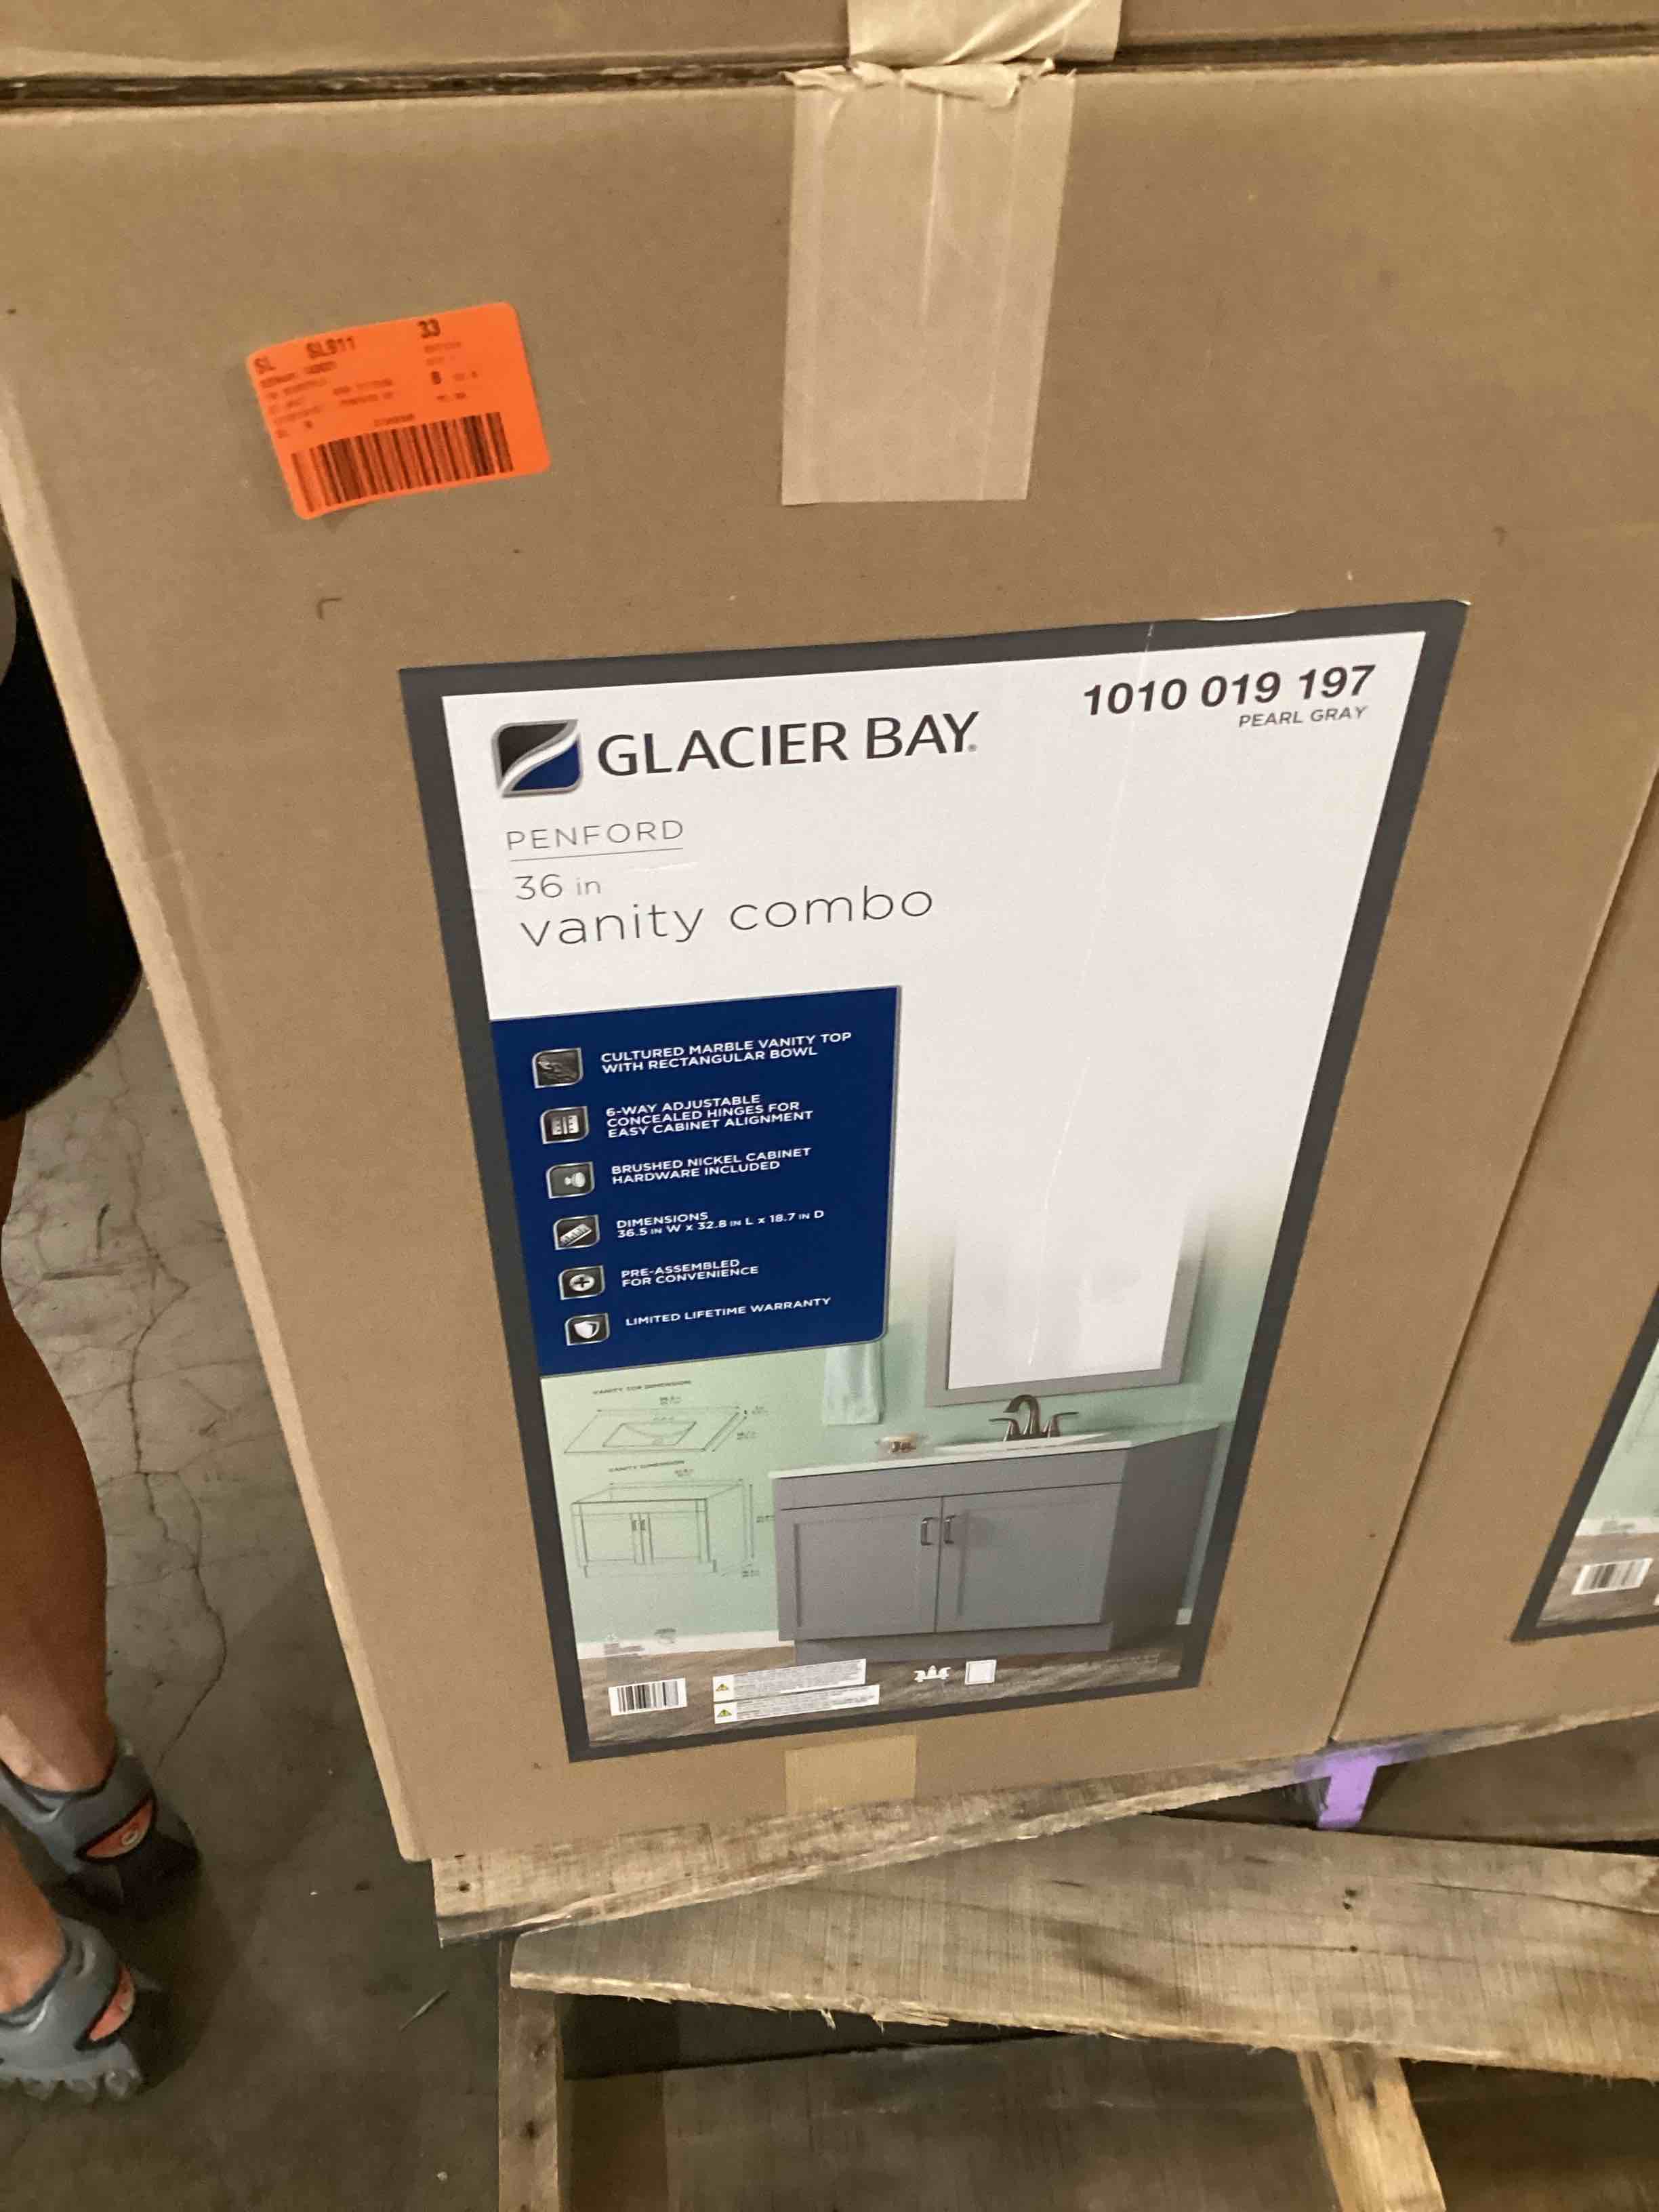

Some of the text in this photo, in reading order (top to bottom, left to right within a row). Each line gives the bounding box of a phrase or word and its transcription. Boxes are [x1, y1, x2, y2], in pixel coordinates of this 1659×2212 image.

[417, 319, 441, 338] 33
[1084, 665, 1376, 716] 1010 019 197
[1238, 705, 1368, 728] PEARL GRAY
[598, 720, 848, 777] GLACIER
[506, 819, 684, 851] PENFORD
[515, 874, 602, 900] 36 in
[521, 885, 933, 947] vanity combo
[601, 1032, 852, 1063] CULTURED MARBLE VANITY TOP
[602, 1047, 817, 1073] WITH RECTANGULAR BOWL
[607, 1094, 760, 1118] 6-WAY ADJUSTABLE
[607, 1101, 800, 1128] CONCEALED HINGES FOR
[609, 1110, 813, 1138] EASY CABINET ALIGNMENT
[612, 1147, 811, 1174] BRUSHED NICKEL CABINET
[613, 1161, 780, 1184] HARDWARE INCLUDED
[617, 1212, 708, 1228] DIMENSIONS
[617, 1227, 648, 1237] 36.5
[667, 1223, 680, 1232] W
[698, 1220, 726, 1230] 32.8
[745, 1217, 753, 1225] L
[769, 1213, 795, 1223] 18.7
[815, 1210, 824, 1218] D
[621, 1259, 739, 1277] PRE-ASSEMBLED
[622, 1267, 759, 1286] FOR CONVENIENCE
[626, 1297, 831, 1326] LIMITED LIFETIME WARRANTY
